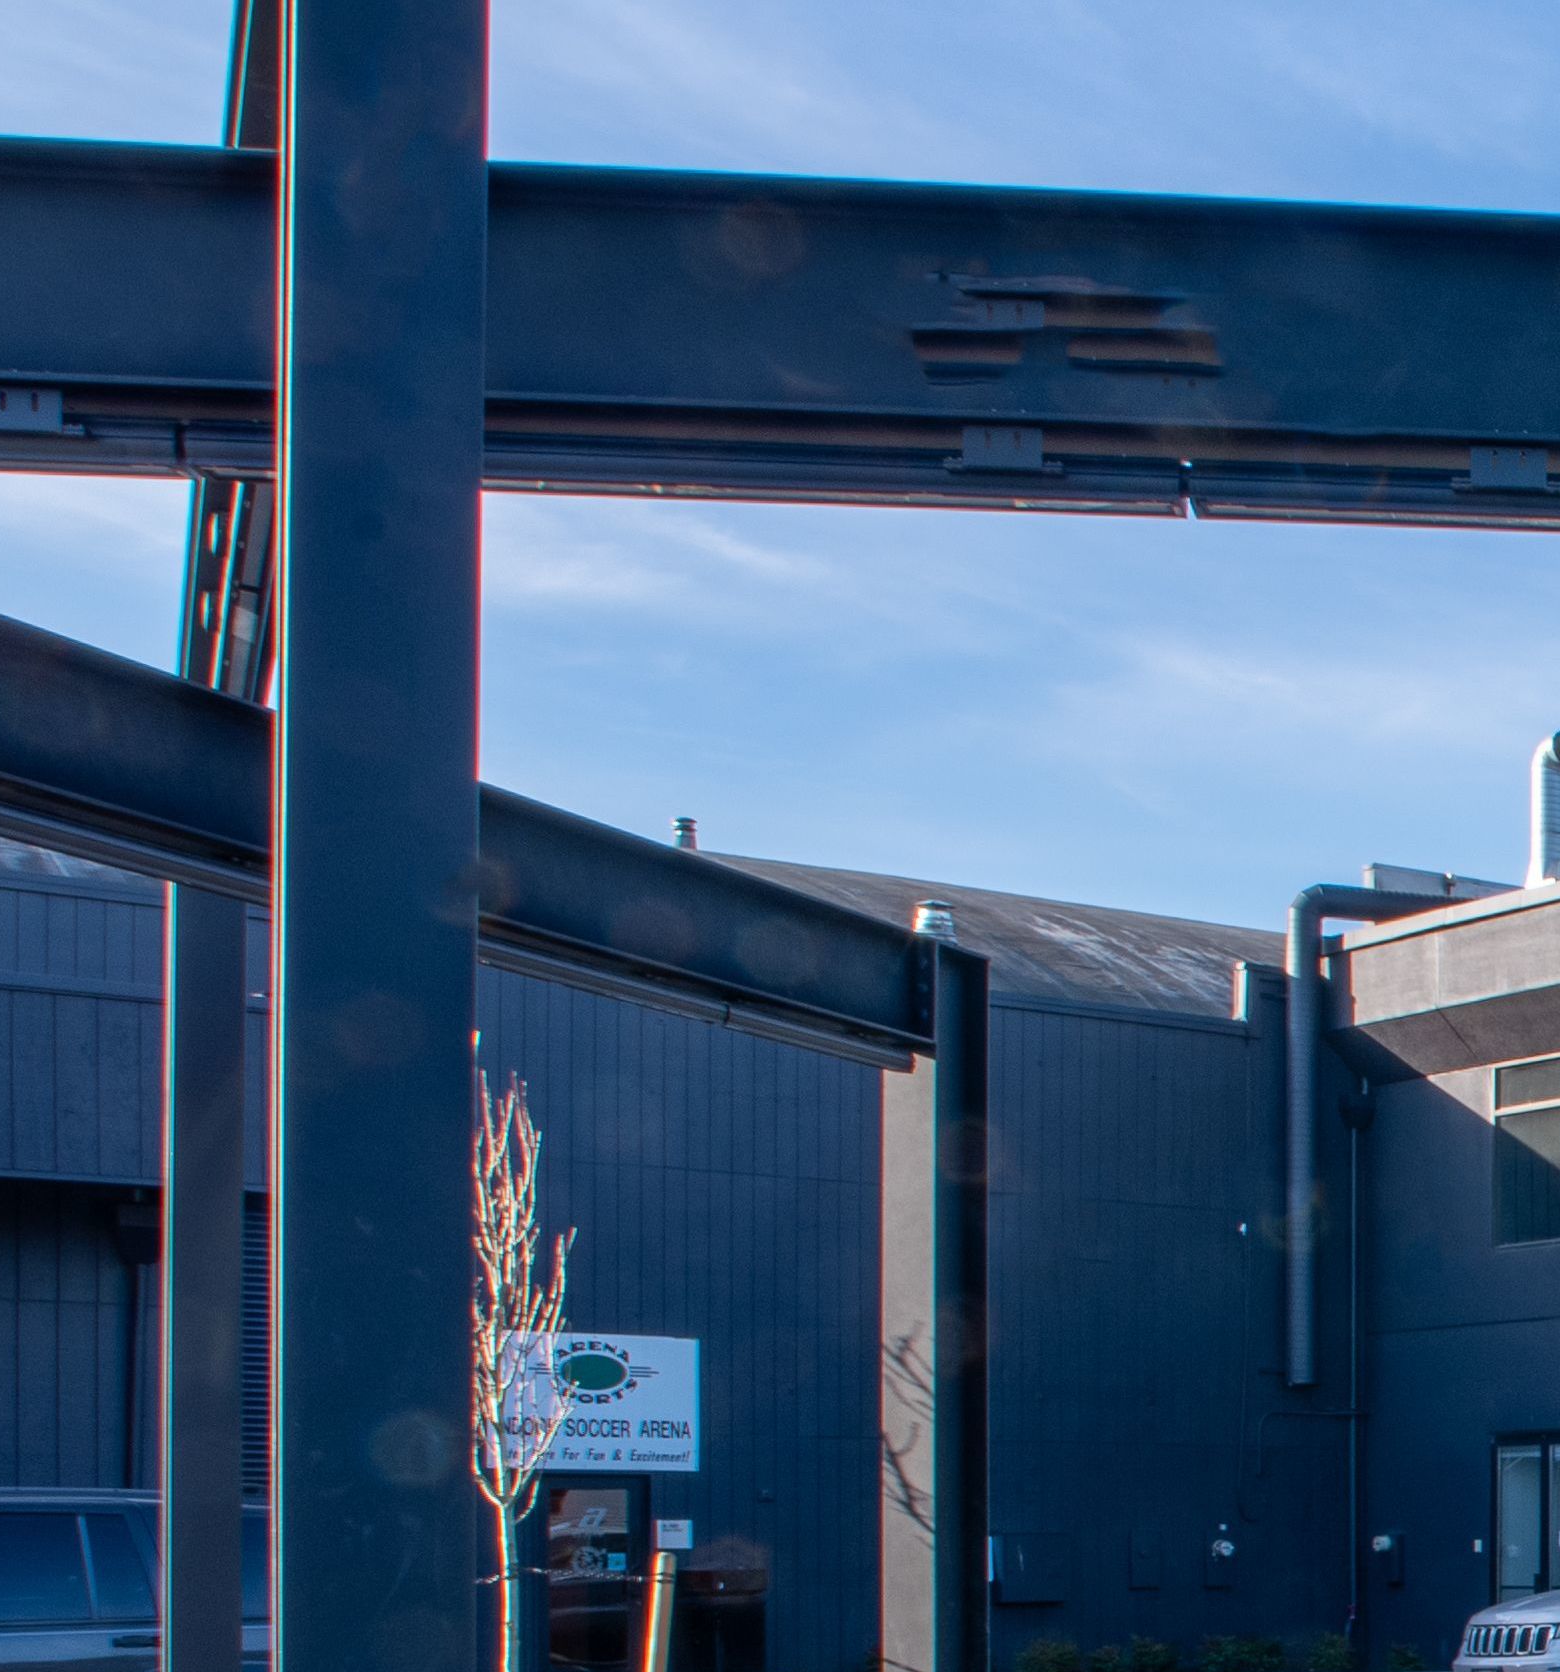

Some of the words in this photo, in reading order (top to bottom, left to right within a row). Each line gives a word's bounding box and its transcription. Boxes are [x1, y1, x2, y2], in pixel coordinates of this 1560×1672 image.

[557, 1341, 629, 1362] ARENA
[565, 1418, 631, 1437] SOCCER
[640, 1419, 691, 1438] ARENA
[563, 1447, 580, 1460] For
[630, 1449, 690, 1463] Excitement!
